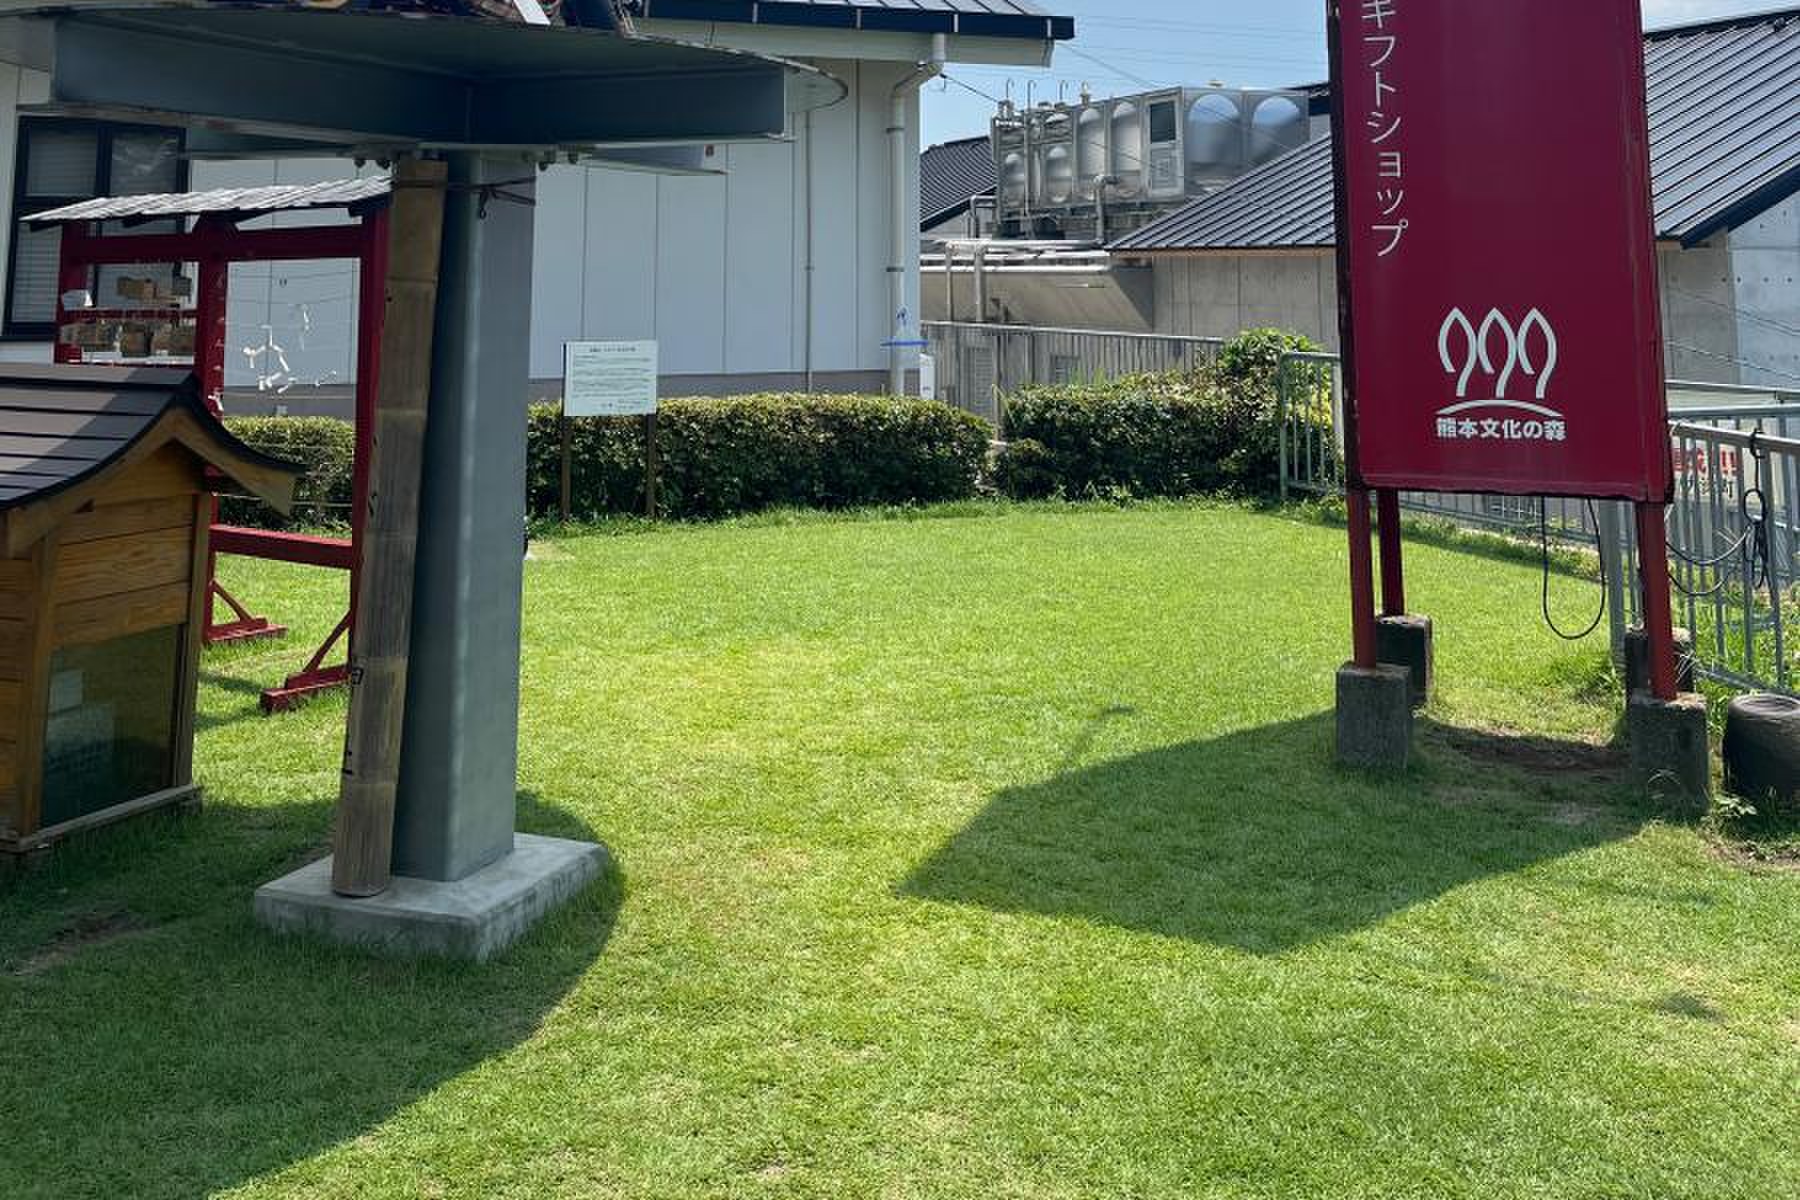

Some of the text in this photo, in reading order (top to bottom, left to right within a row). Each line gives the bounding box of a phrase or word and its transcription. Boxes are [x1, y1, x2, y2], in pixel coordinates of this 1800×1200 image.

[1436, 417, 1566, 441] 熊本文化の森
